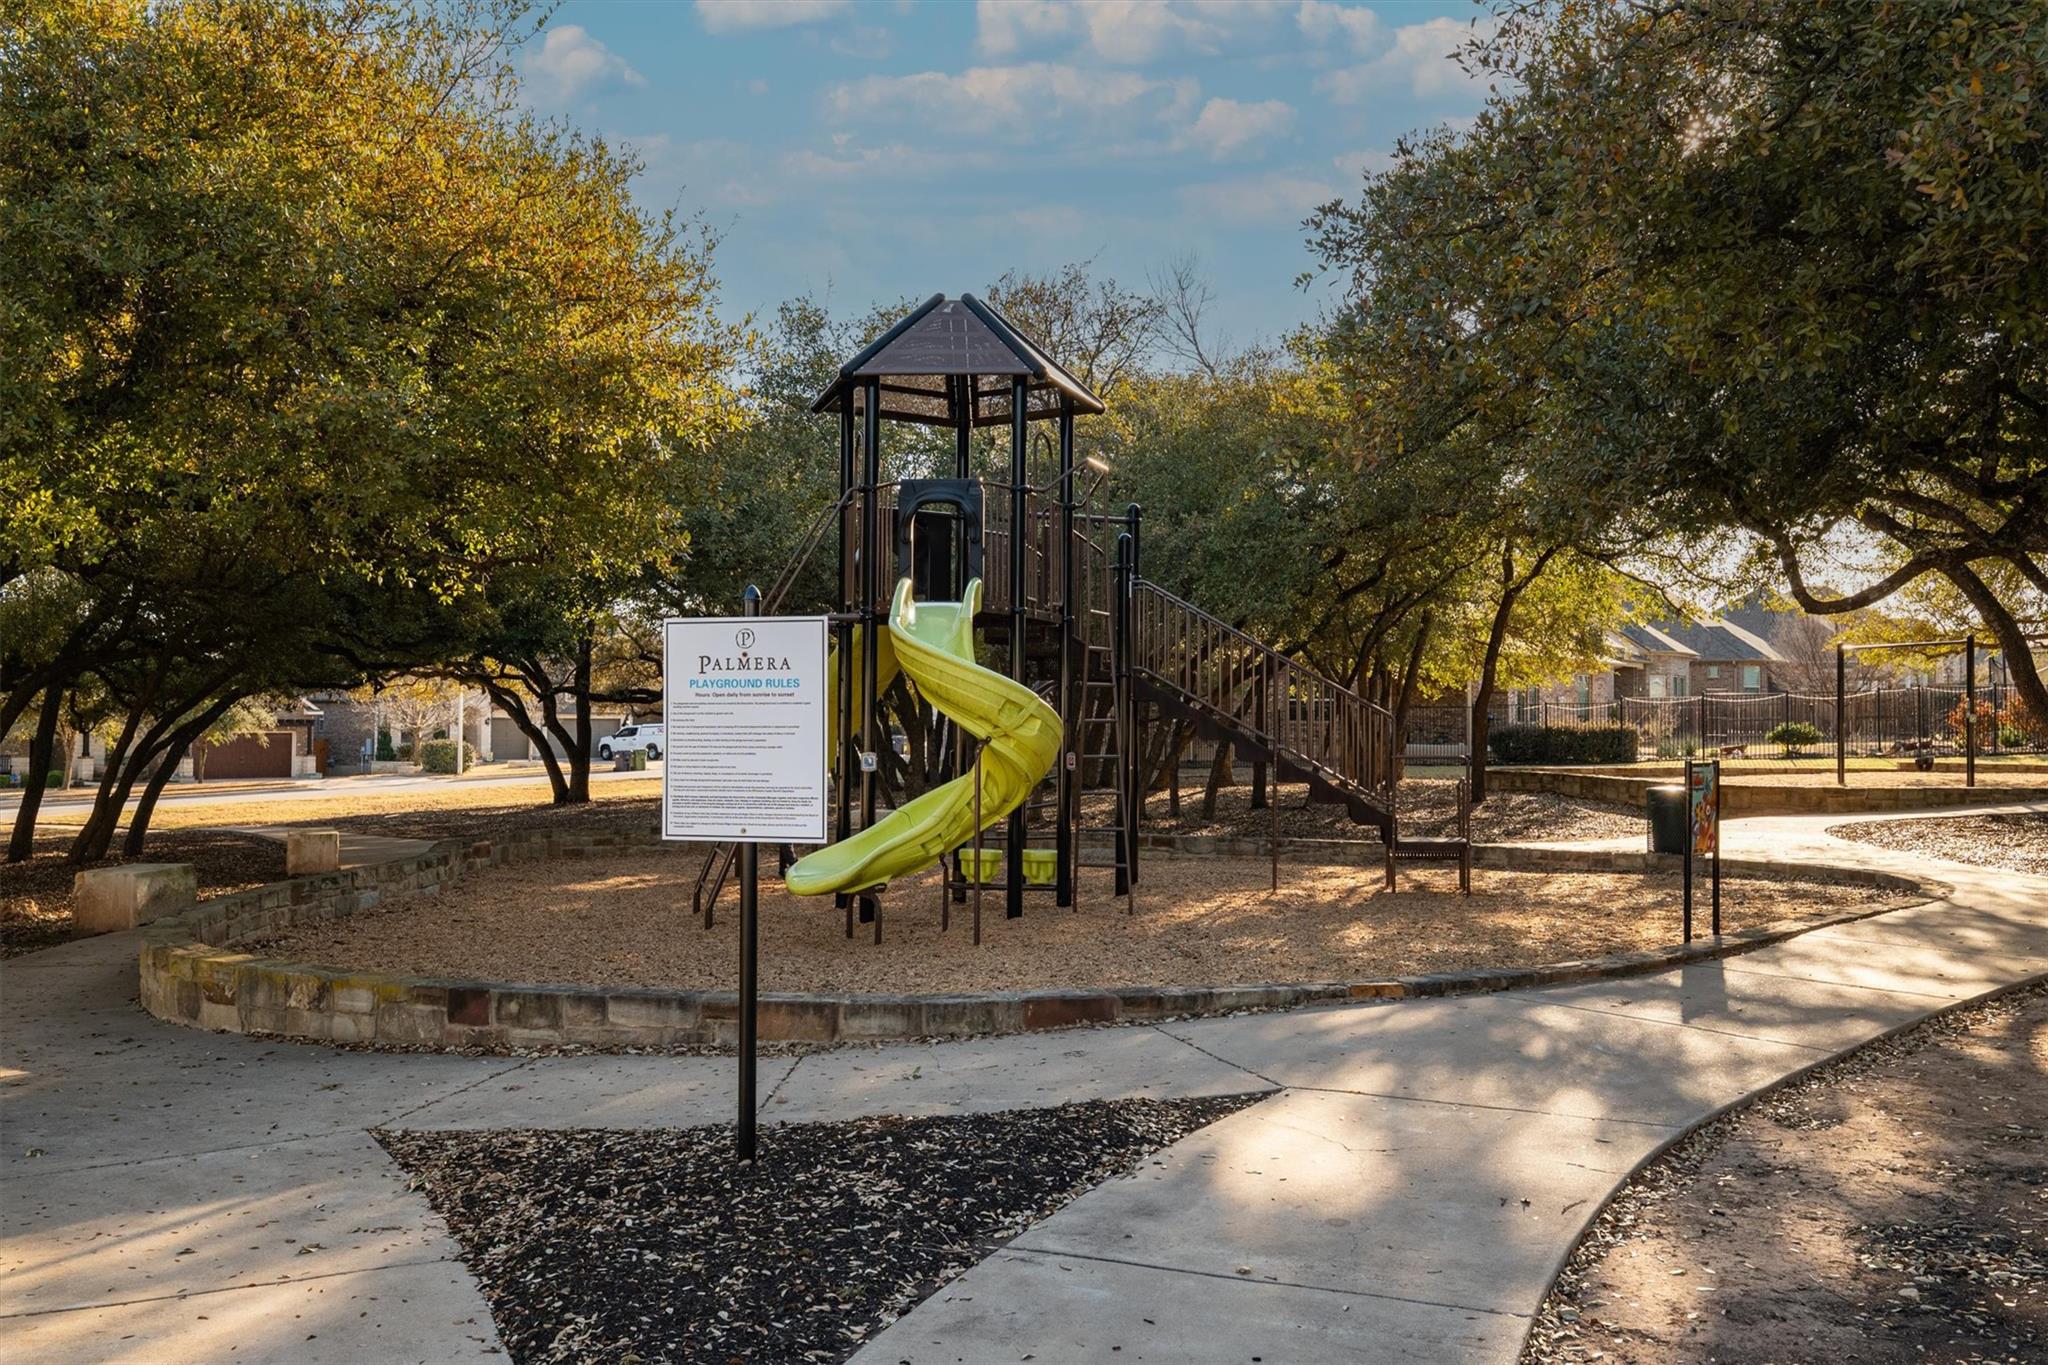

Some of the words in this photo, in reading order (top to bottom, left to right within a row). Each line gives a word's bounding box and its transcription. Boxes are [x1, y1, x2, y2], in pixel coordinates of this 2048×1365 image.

[741, 632, 751, 646] P
[699, 655, 791, 674] PALMERA
[689, 678, 763, 689] PLAYGROUND
[765, 678, 800, 688] RULES
